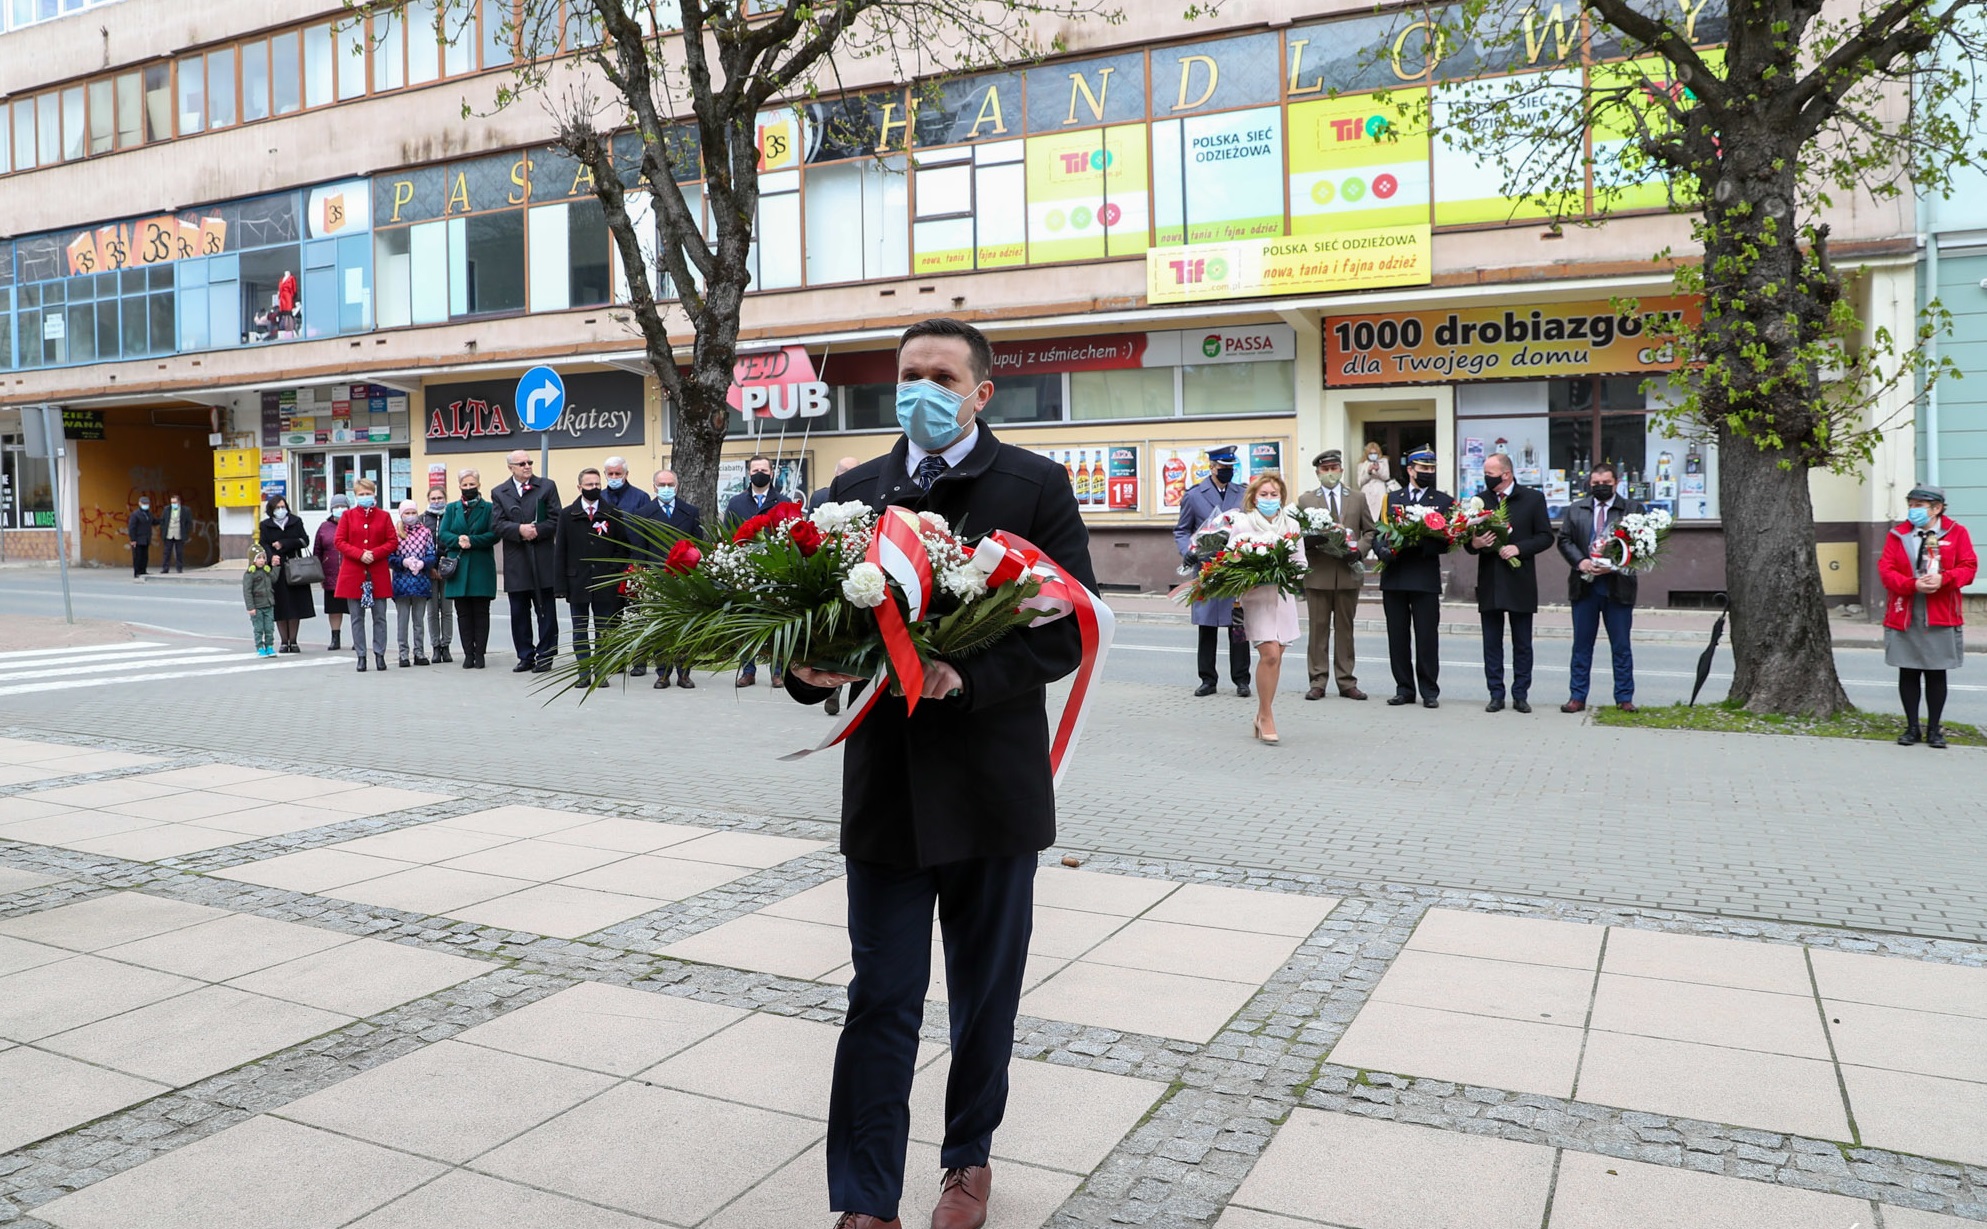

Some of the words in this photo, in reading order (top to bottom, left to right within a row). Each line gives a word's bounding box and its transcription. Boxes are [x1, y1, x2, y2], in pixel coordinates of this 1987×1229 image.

[390, 134, 670, 222] PASA
[874, 0, 1707, 152] HANDLOWY
[1519, 92, 1548, 109] SIEĆ
[1193, 133, 1240, 148] POLSKA
[1247, 126, 1273, 142] SIEĆ
[1196, 144, 1271, 162] ODZIEŻOWA
[1190, 228, 1212, 240] tania
[1225, 226, 1246, 240] fajna
[1251, 222, 1278, 234] odzież
[946, 252, 965, 263] tania
[979, 248, 997, 262] fajna
[1263, 244, 1308, 256] POLSKA
[1314, 240, 1339, 253] SIEĆ
[1342, 234, 1416, 250] ODZIEŻOWA
[1264, 267, 1295, 279] nowa,
[1300, 261, 1329, 277] tania
[1333, 259, 1338, 275] i
[1379, 254, 1417, 271] odzież
[1334, 317, 1423, 352] 1000
[1434, 306, 1684, 348] drobiazgów
[1027, 352, 1035, 363] z
[1040, 344, 1117, 363] uśmiechem
[1122, 341, 1133, 360] :)
[1225, 335, 1273, 351] PASSA
[736, 350, 790, 387] ED
[1343, 353, 1381, 375] dla
[1392, 349, 1500, 376] Twojego
[1511, 345, 1589, 367] domu
[742, 381, 831, 421] PUB
[426, 397, 511, 440] ALTA
[519, 403, 633, 438] ikatesy
[1112, 482, 1122, 504] 1
[1829, 560, 1840, 571] G
